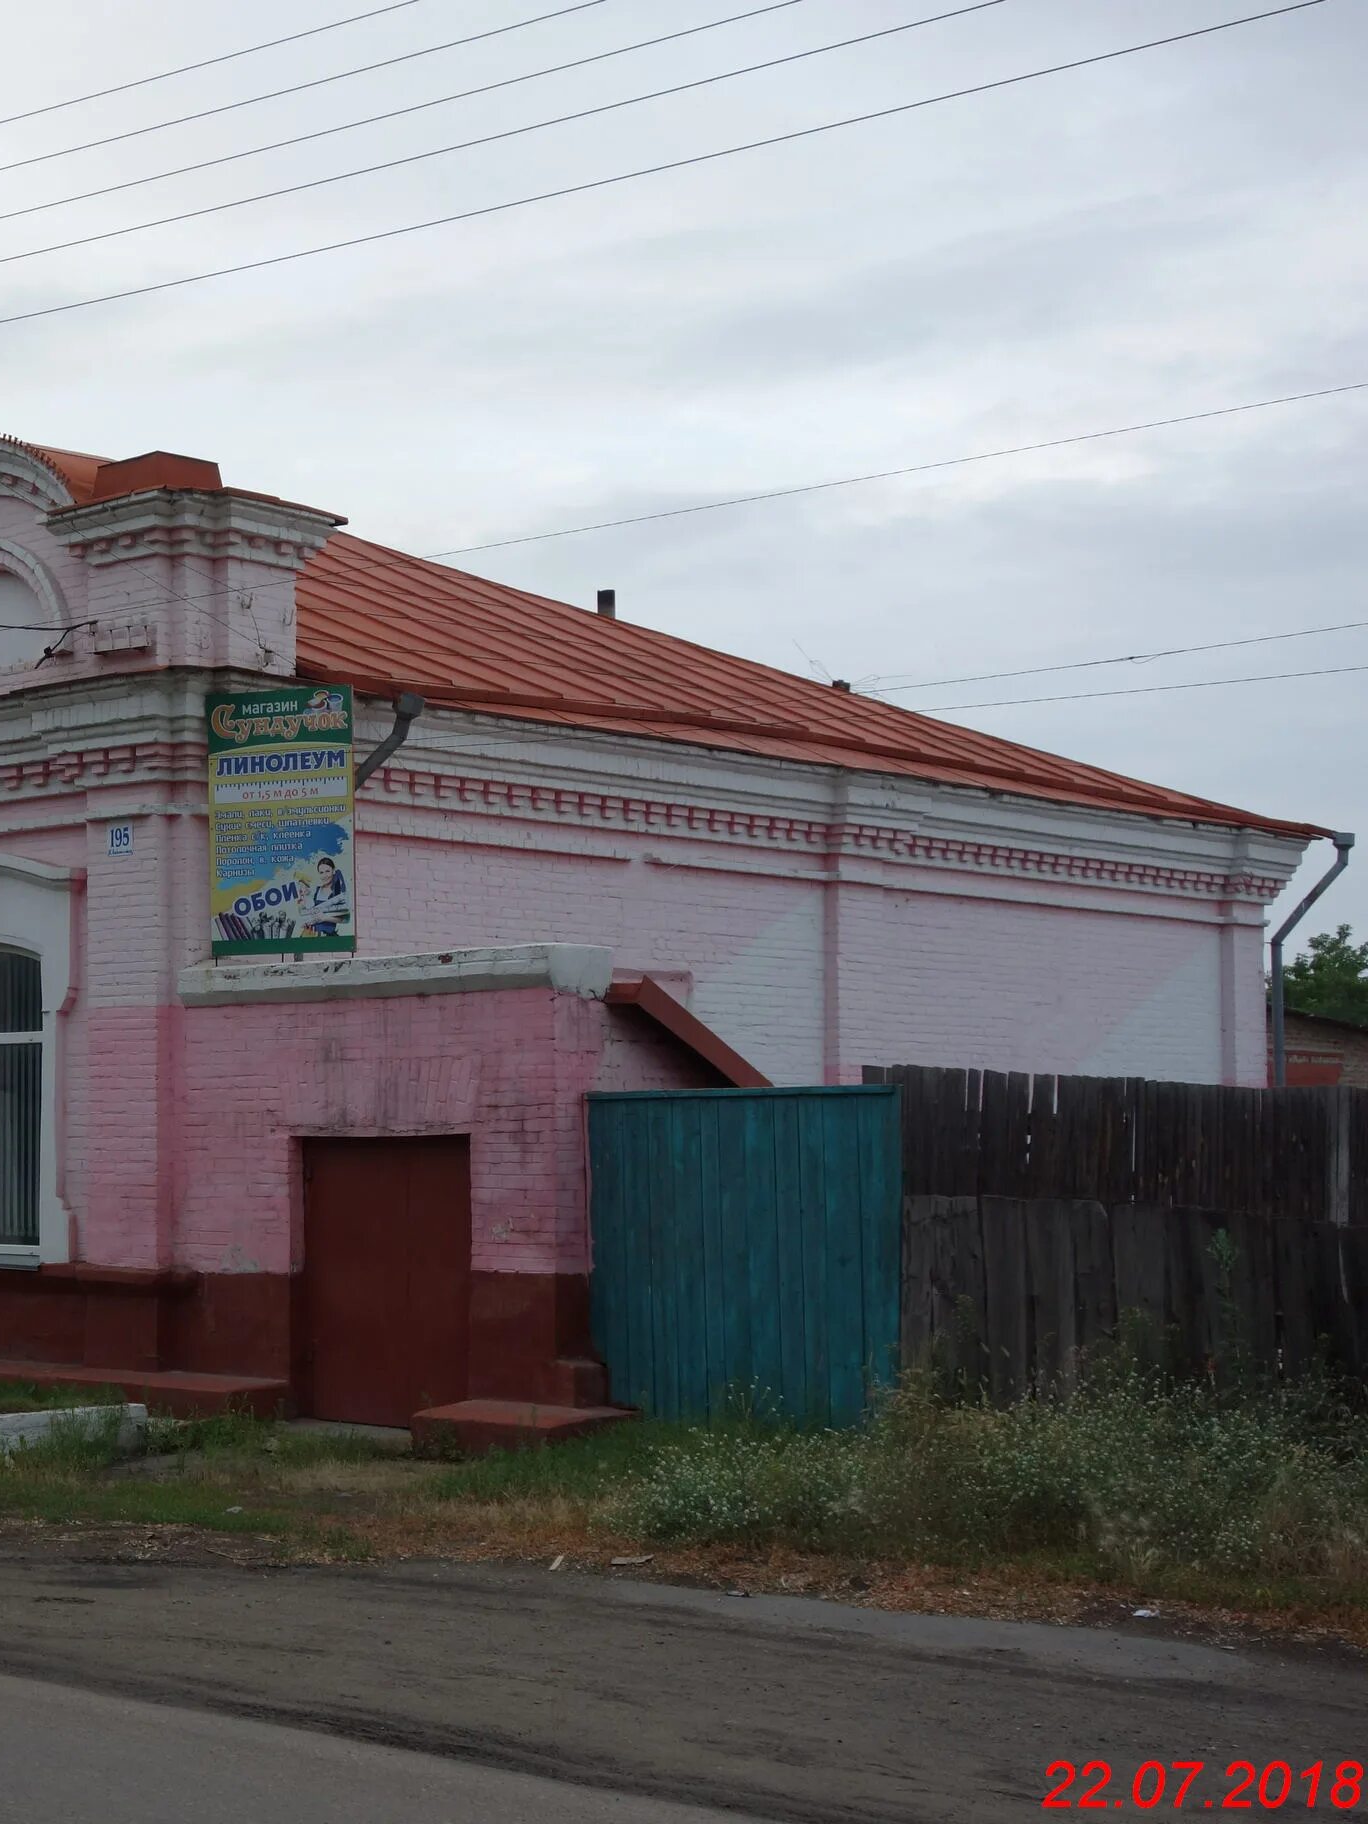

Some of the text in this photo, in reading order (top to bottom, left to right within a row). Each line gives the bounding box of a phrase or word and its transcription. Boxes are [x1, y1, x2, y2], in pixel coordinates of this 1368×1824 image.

[242, 700, 298, 715] магазин
[211, 704, 348, 743] Сундучок
[217, 749, 345, 776] ЛИНОЛЕУМ
[242, 792, 254, 800] от
[258, 790, 271, 800] 1,5
[284, 788, 298, 799] до
[301, 787, 307, 797] 5
[110, 826, 130, 847] 195
[216, 842, 303, 854] Потолочная плитка
[216, 868, 255, 878] Карнизы
[234, 881, 299, 916] ОБОИ
